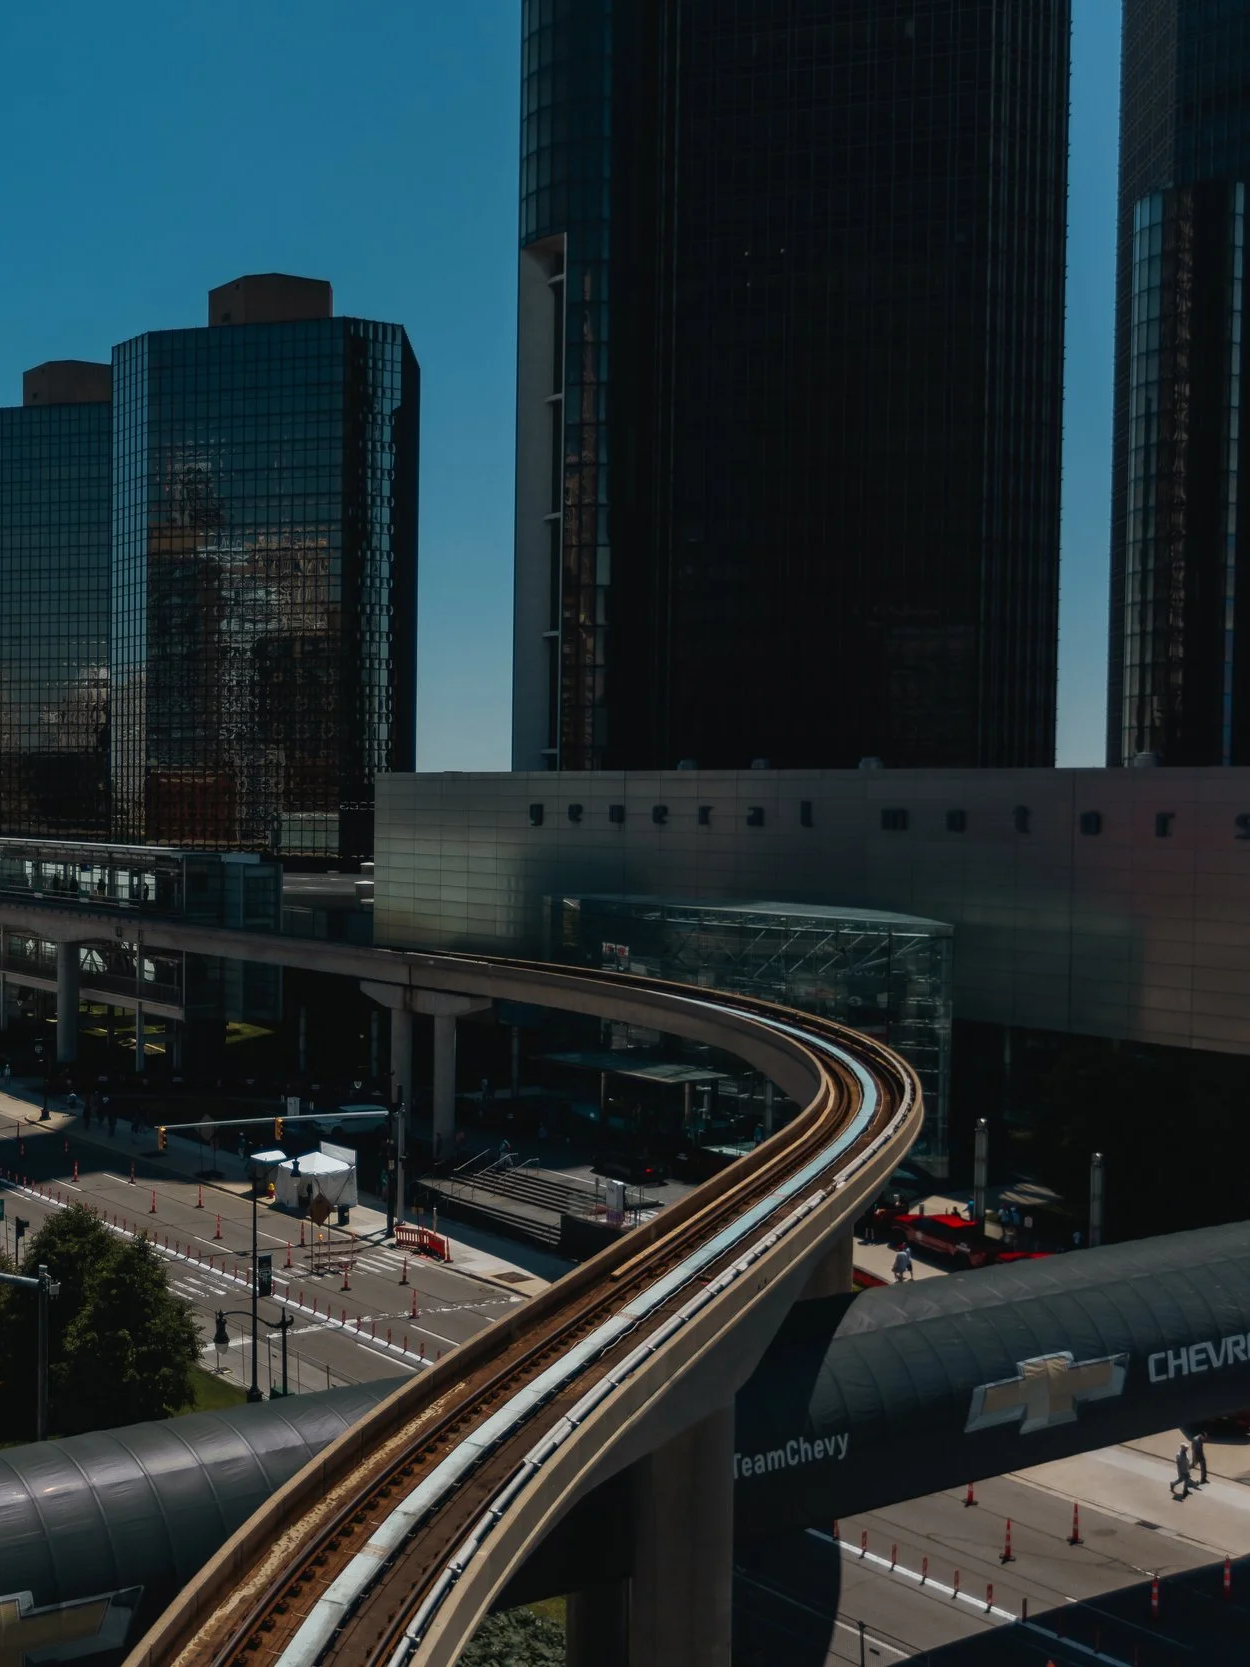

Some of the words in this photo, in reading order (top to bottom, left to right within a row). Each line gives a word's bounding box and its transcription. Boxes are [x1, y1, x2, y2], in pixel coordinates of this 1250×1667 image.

[529, 800, 815, 828] general
[1147, 1332, 1250, 1383] CHEVR
[733, 1432, 850, 1480] TeamChevy
